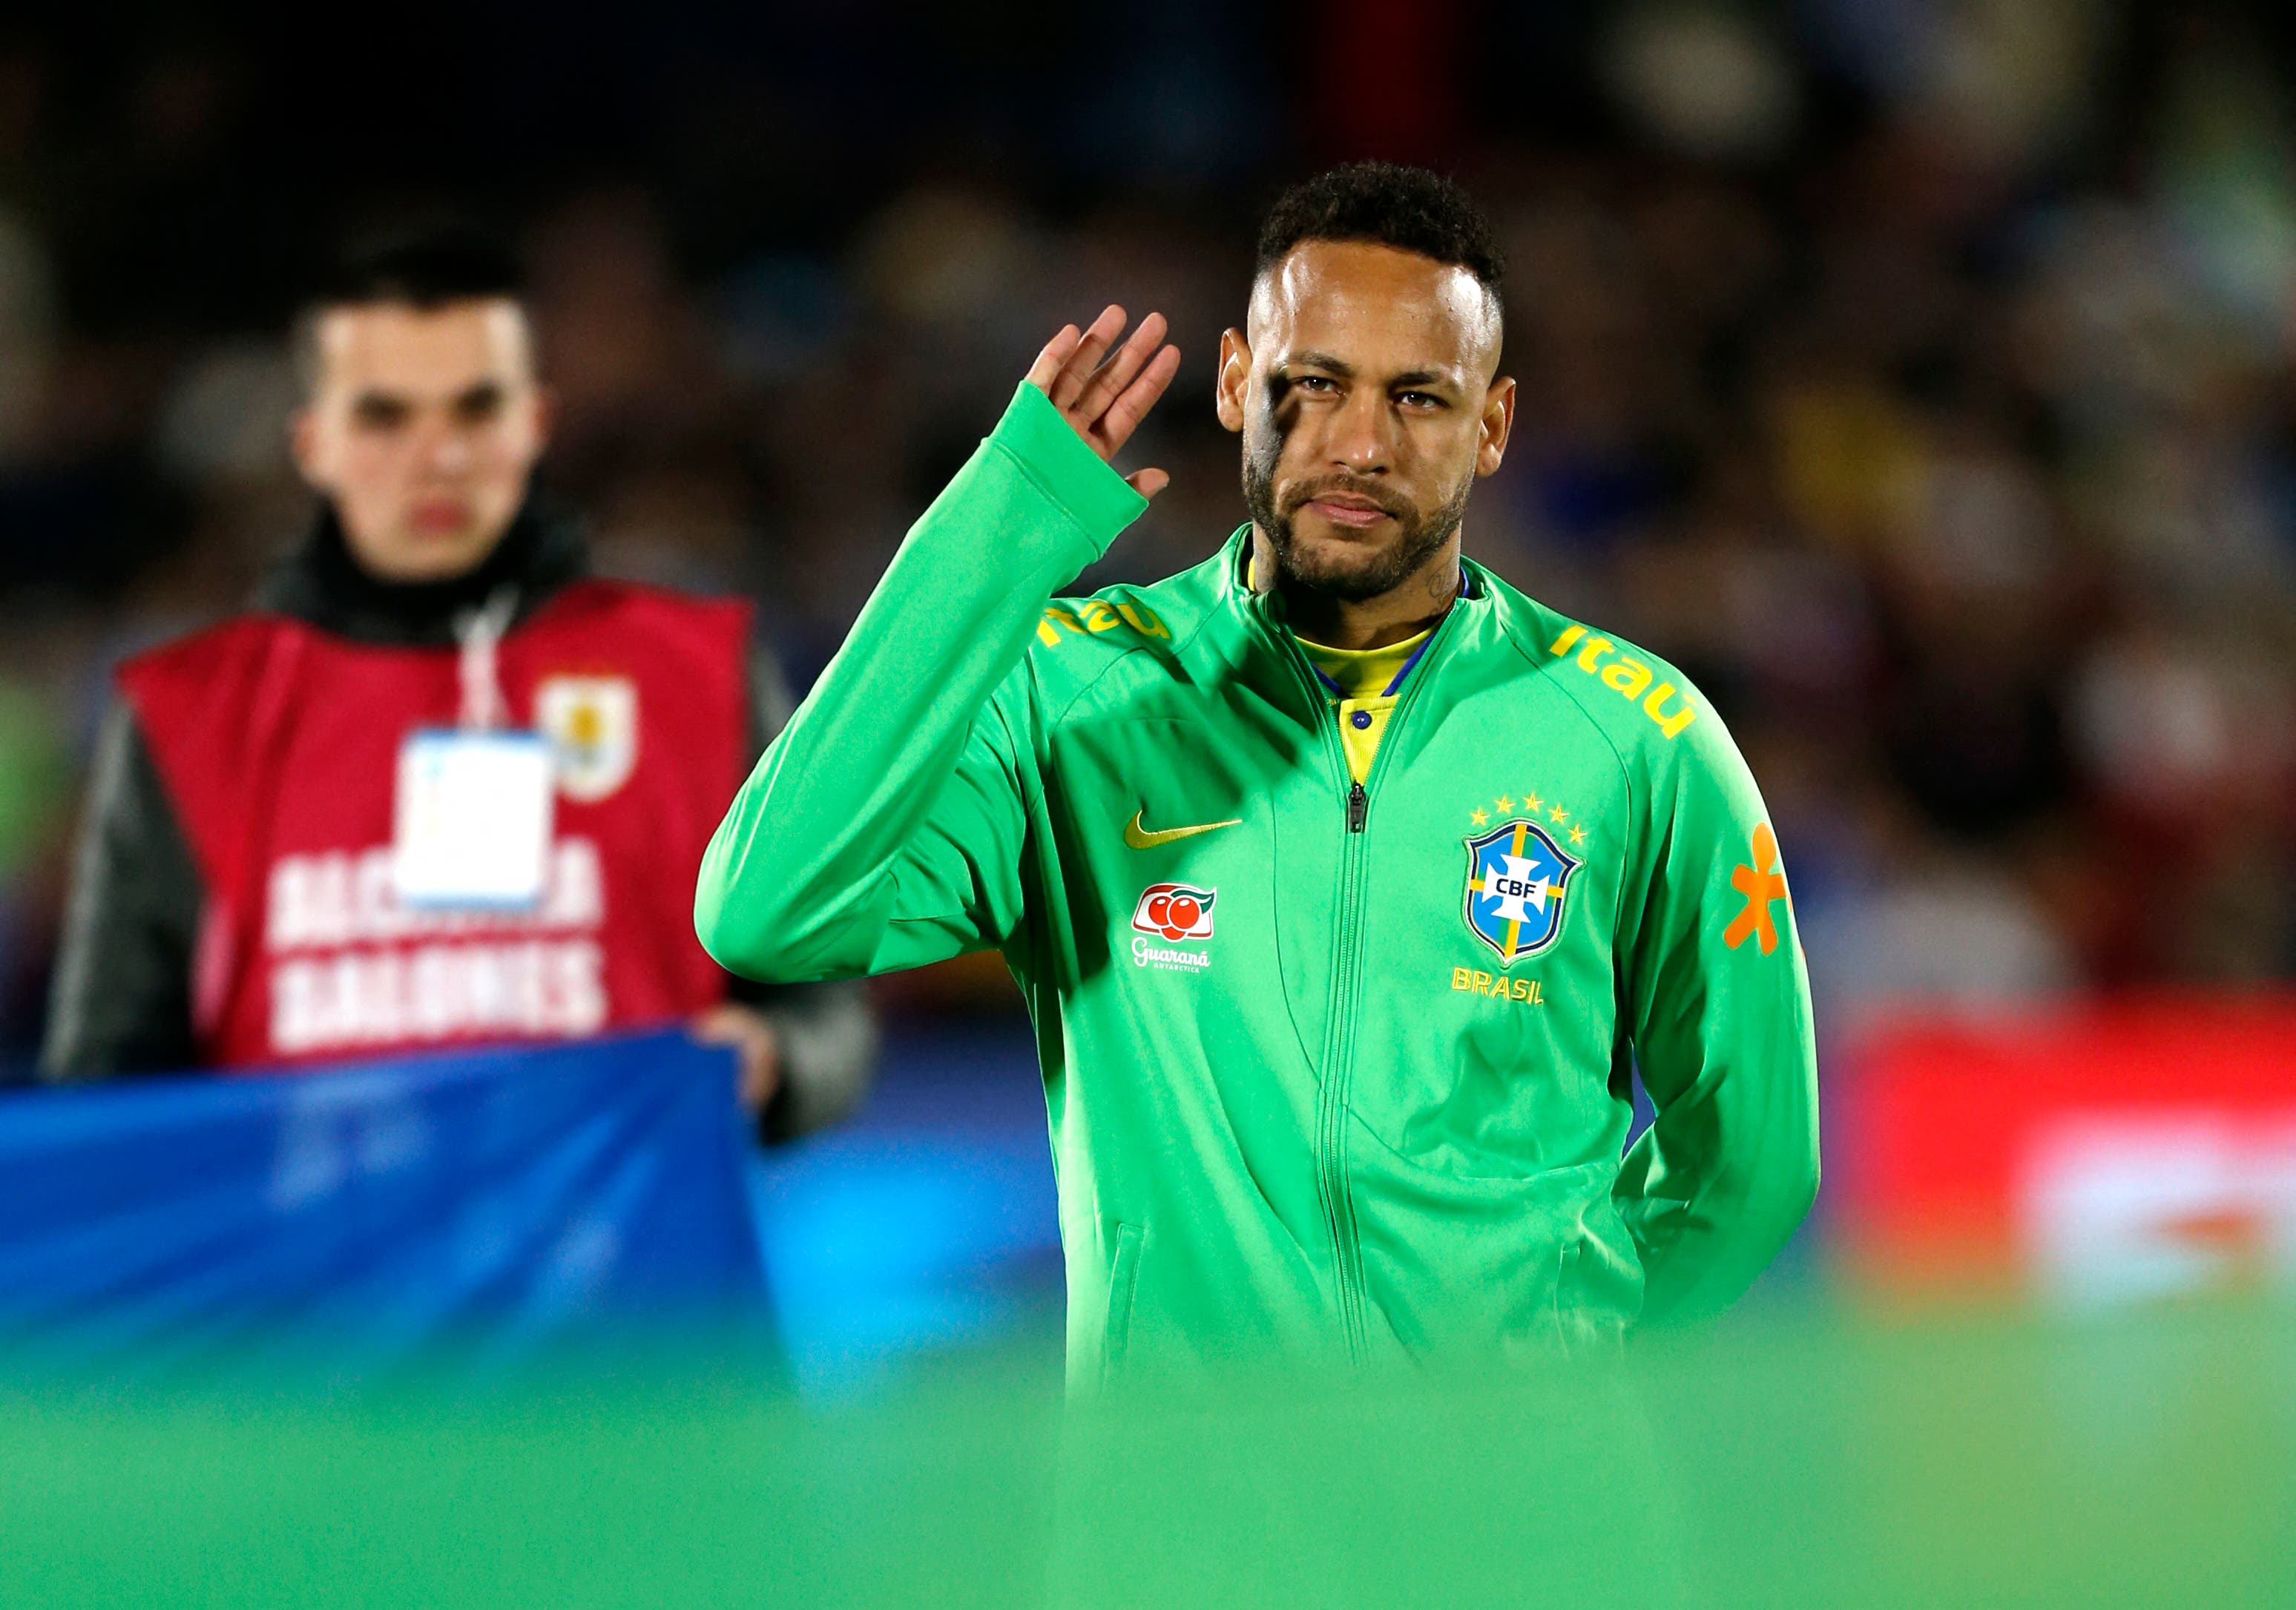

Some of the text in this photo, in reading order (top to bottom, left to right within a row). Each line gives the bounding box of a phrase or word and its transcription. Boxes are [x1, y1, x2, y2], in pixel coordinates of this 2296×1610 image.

[1496, 878, 1536, 898] CBF
[1131, 936, 1211, 967] Guaraná
[1154, 962, 1200, 973] ANTARCTICA
[1452, 967, 1544, 1005] BRASIL
